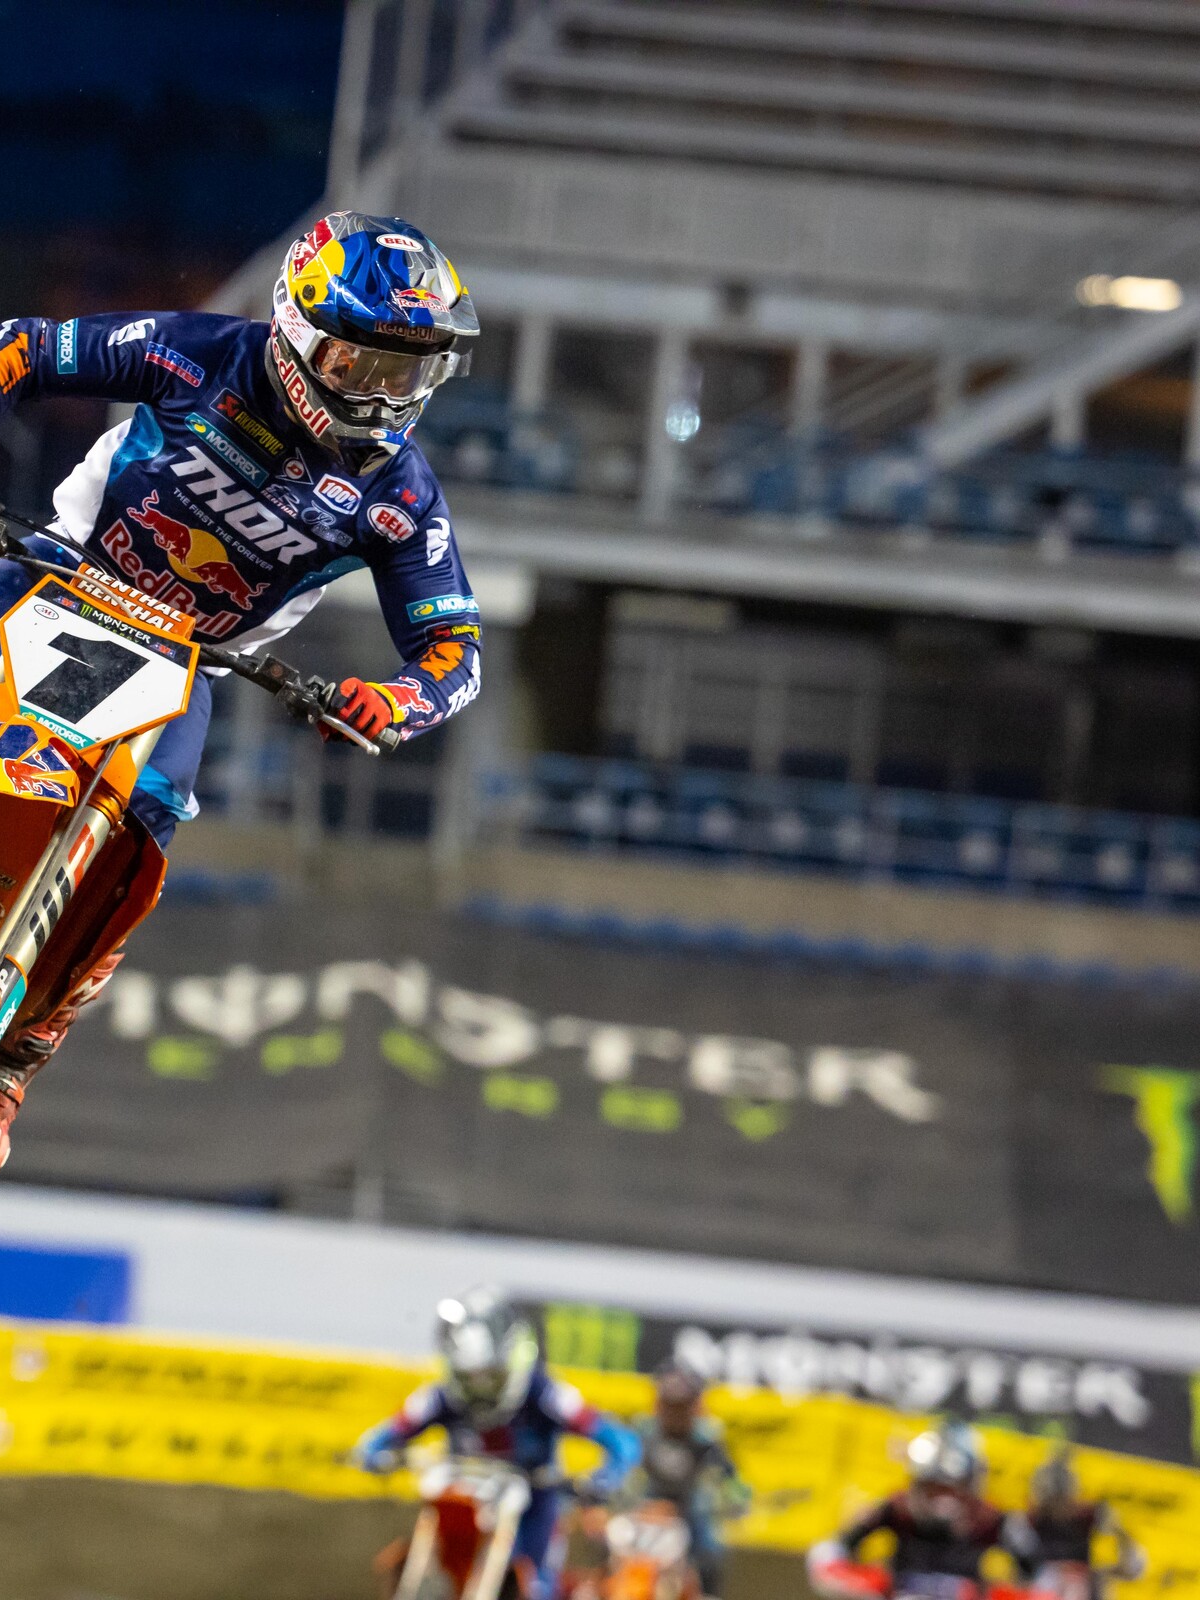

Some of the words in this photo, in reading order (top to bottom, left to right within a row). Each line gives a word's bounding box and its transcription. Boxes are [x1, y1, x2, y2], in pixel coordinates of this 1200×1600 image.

[383, 238, 417, 248] BELL
[398, 299, 427, 308] Red
[426, 300, 450, 313] Bull
[60, 319, 75, 366] OTOREX
[147, 341, 205, 380] PARTS
[286, 372, 333, 438] Bull
[205, 431, 261, 481] MOTOREX
[170, 445, 317, 565] THOR
[260, 489, 298, 520] RENTHAL
[320, 482, 357, 510] 100%
[173, 487, 190, 507] THE
[188, 503, 215, 527] FIRST
[215, 526, 233, 544] THE
[231, 540, 273, 572] FOREVER
[84, 567, 183, 623] RENTHAL
[101, 518, 175, 601] Red
[166, 582, 243, 639] Bull
[92, 610, 152, 644] MONSTER
[36, 716, 89, 748] MOTOREX
